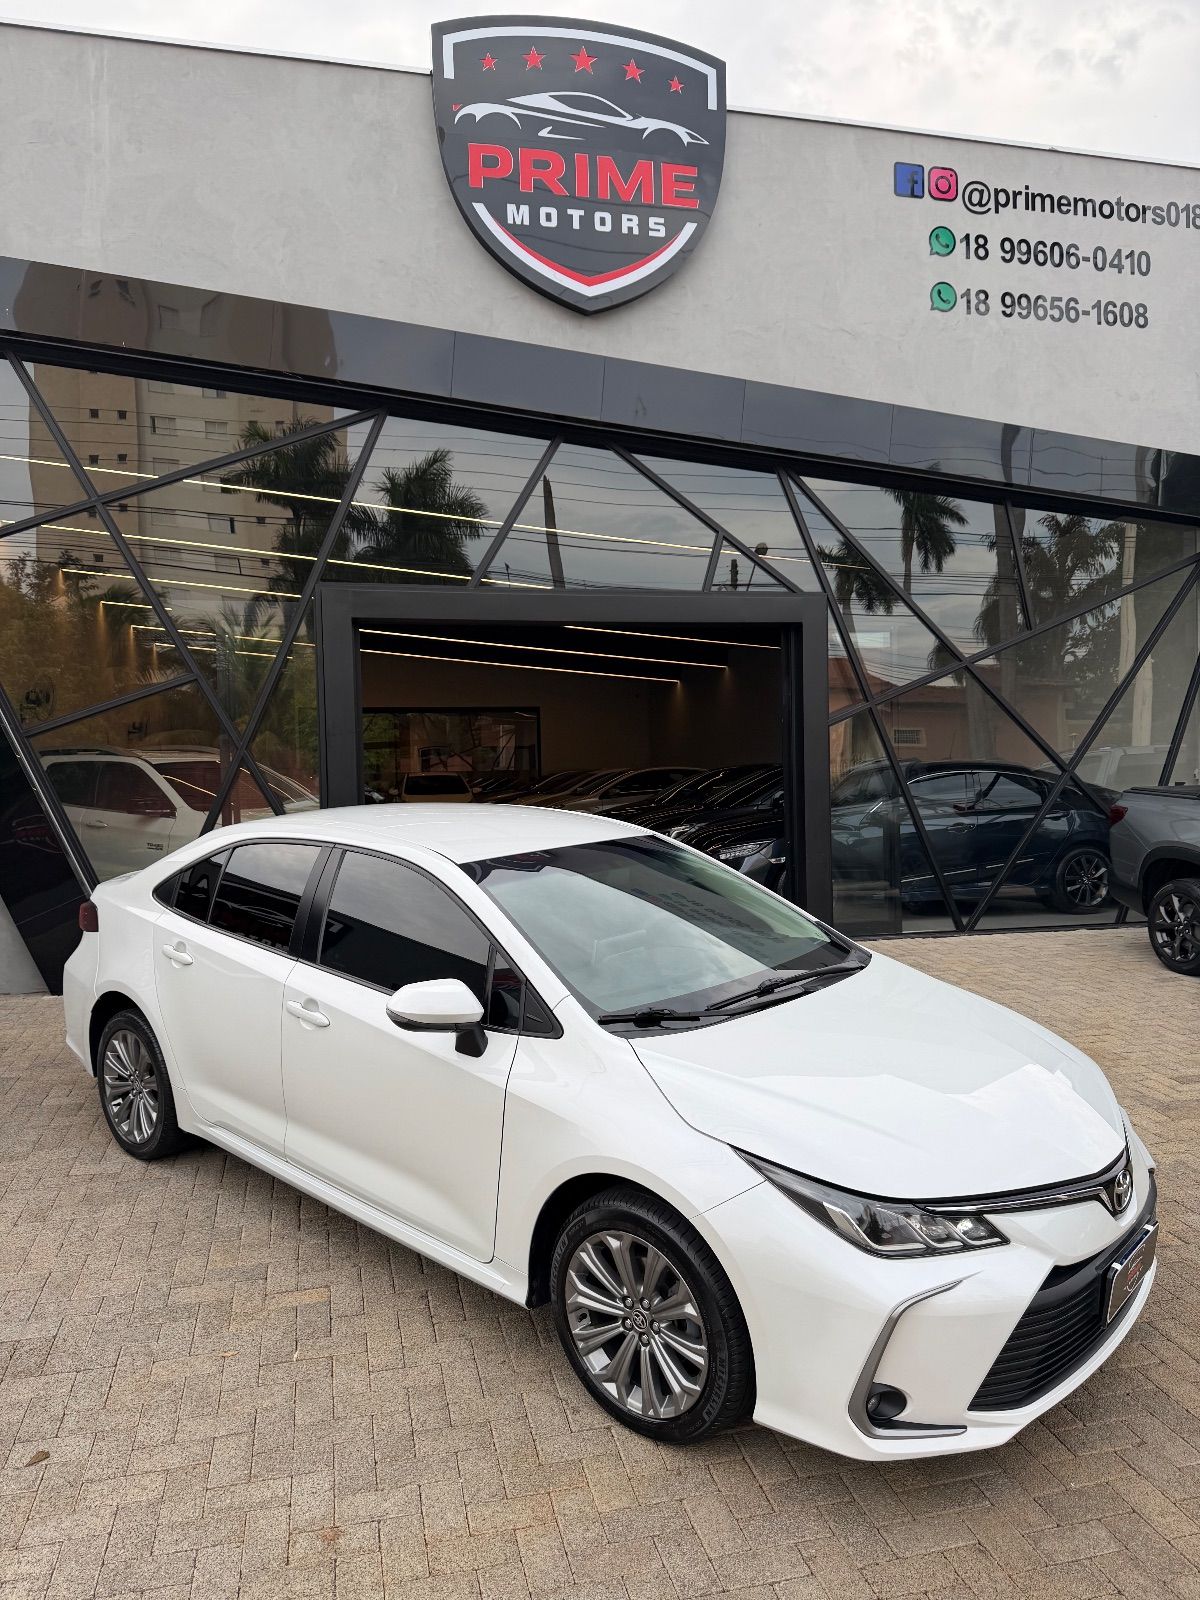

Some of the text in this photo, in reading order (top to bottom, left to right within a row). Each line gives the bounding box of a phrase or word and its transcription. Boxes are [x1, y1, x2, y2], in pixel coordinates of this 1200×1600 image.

[467, 142, 700, 209] PRIME
[506, 203, 667, 238] MOTORS
[961, 180, 1200, 230] @primemotors018
[959, 232, 1151, 277] 18 99606-0410
[960, 288, 1149, 329] 18 99656-1608
